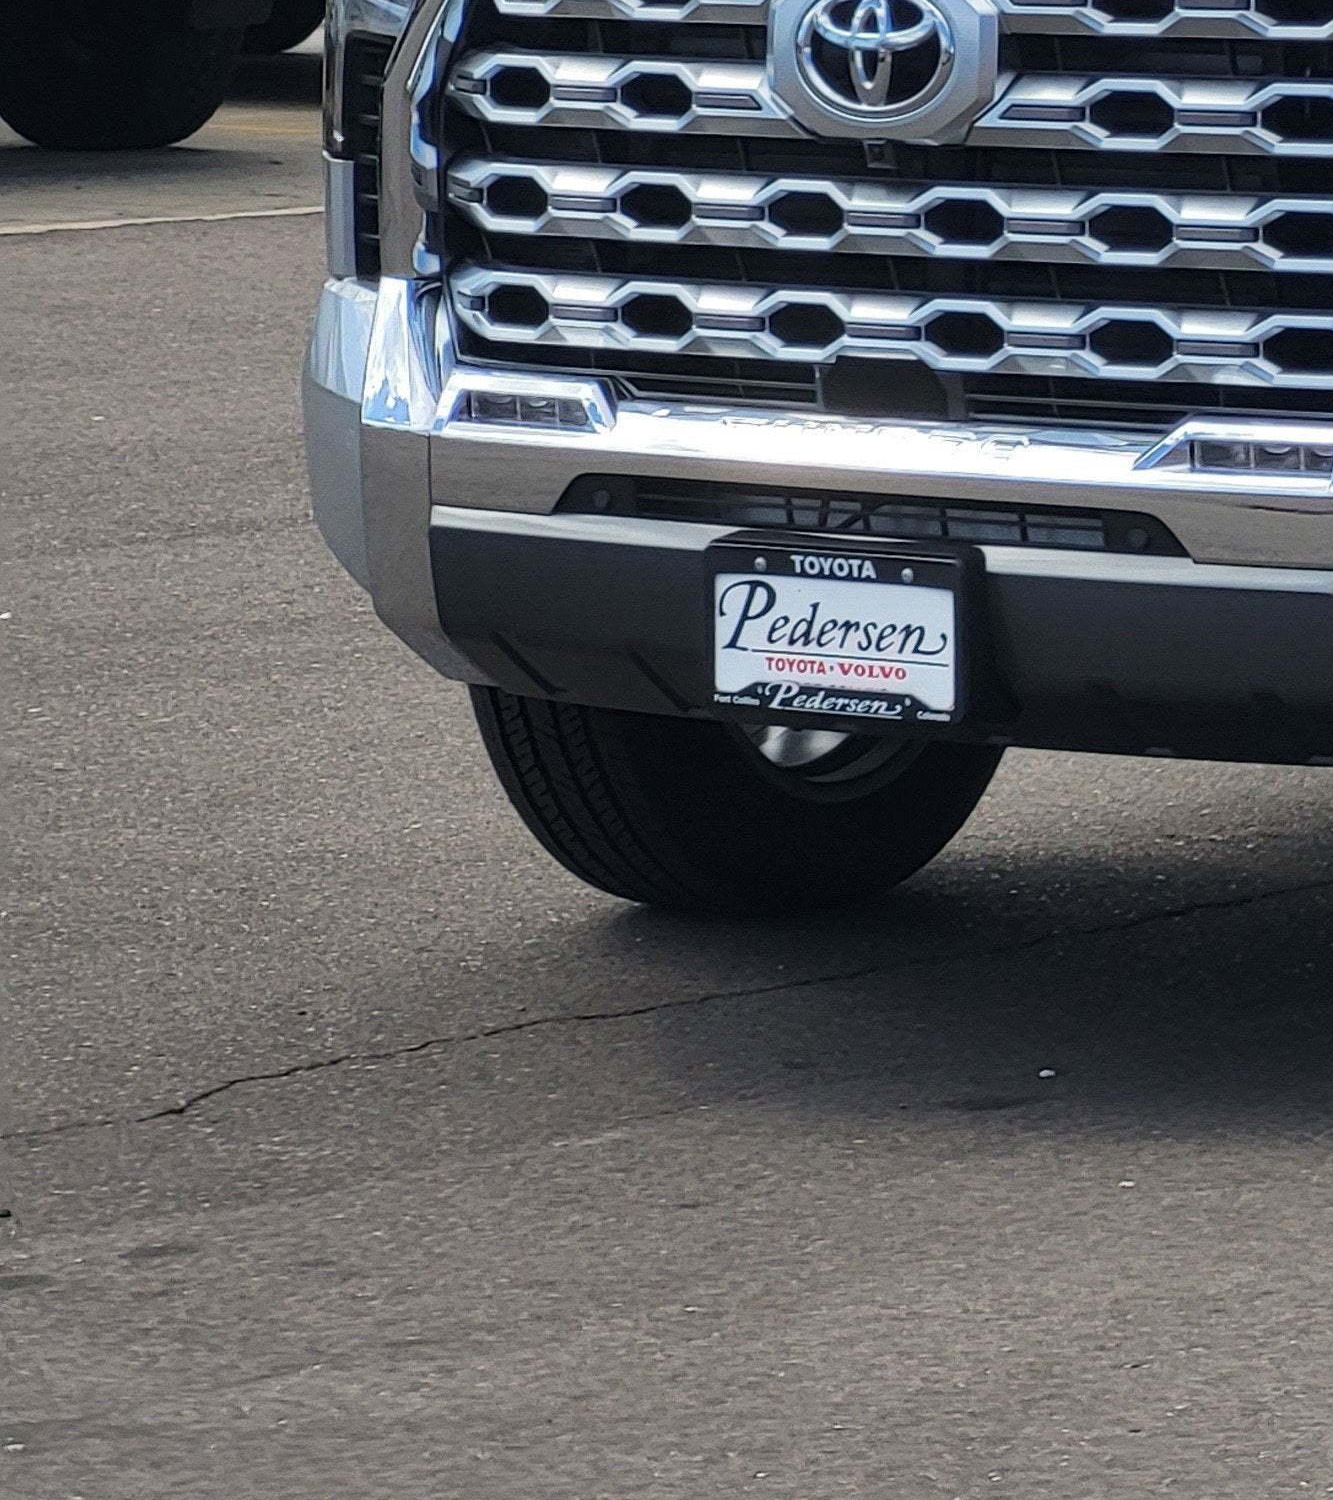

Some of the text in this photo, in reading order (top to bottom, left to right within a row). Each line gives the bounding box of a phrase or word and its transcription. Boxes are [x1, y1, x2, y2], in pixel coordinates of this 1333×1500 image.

[790, 554, 877, 579] TOYOTA
[719, 579, 948, 656] Pedersen
[765, 657, 907, 680] TOYOTA VOLVO
[764, 680, 903, 715] Pedersen
